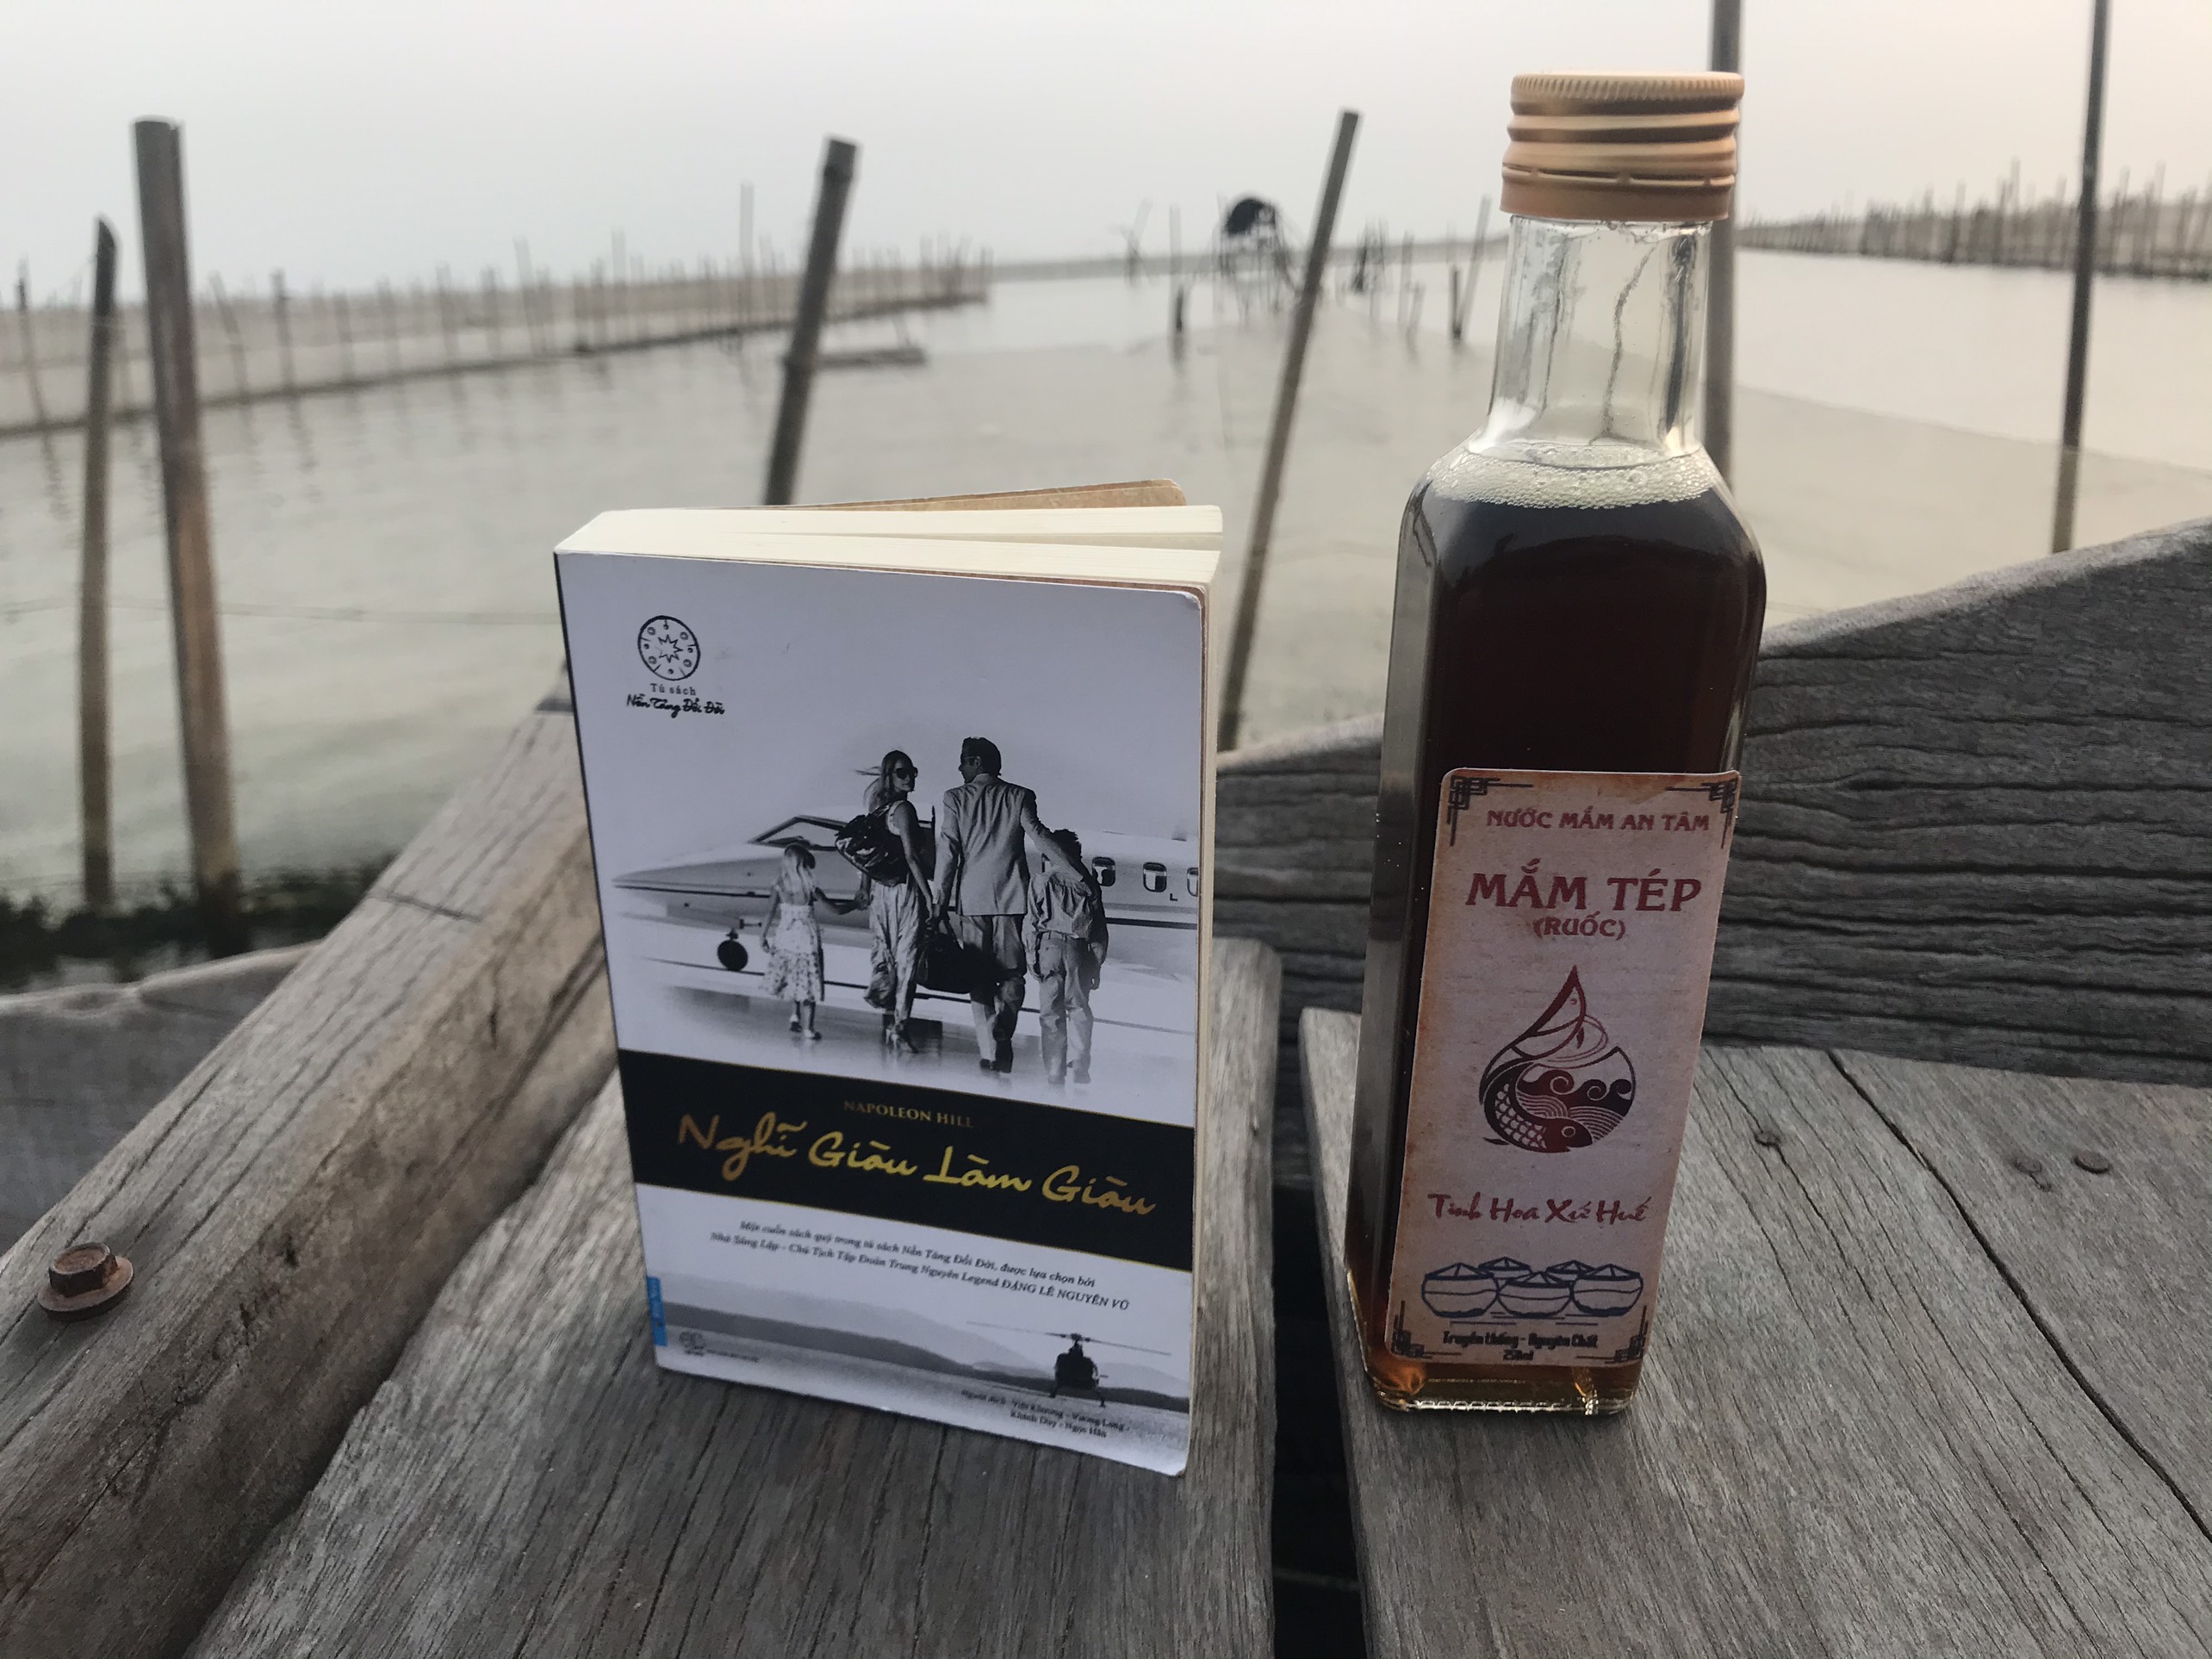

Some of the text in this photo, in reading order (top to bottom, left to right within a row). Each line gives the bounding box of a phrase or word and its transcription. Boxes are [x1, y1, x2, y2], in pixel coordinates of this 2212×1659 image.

[669, 685, 696, 696] sách
[1487, 805, 1710, 831] NƯỚC MẮM AN TÂM
[1464, 858, 1701, 912] MẮM TÉP
[1532, 910, 1626, 941] (RUỐC)
[843, 1101, 973, 1128] NAPOLEON HILL
[677, 1111, 1156, 1215] Nghĩ Giàu Làm Giàu
[1427, 1191, 1652, 1225] Tinh Hoa Xứ Huế
[789, 1229, 811, 1239] sách
[835, 1235, 861, 1249] trong
[876, 1242, 900, 1252] sách
[1029, 1267, 1047, 1280] lựa
[1049, 1271, 1074, 1285] chọn
[1078, 1276, 1096, 1289] bởi
[889, 1259, 919, 1274] Trung
[961, 1272, 999, 1287] Legend
[1039, 1286, 1054, 1297] LÊ
[1057, 1289, 1108, 1308] NGUYÊN
